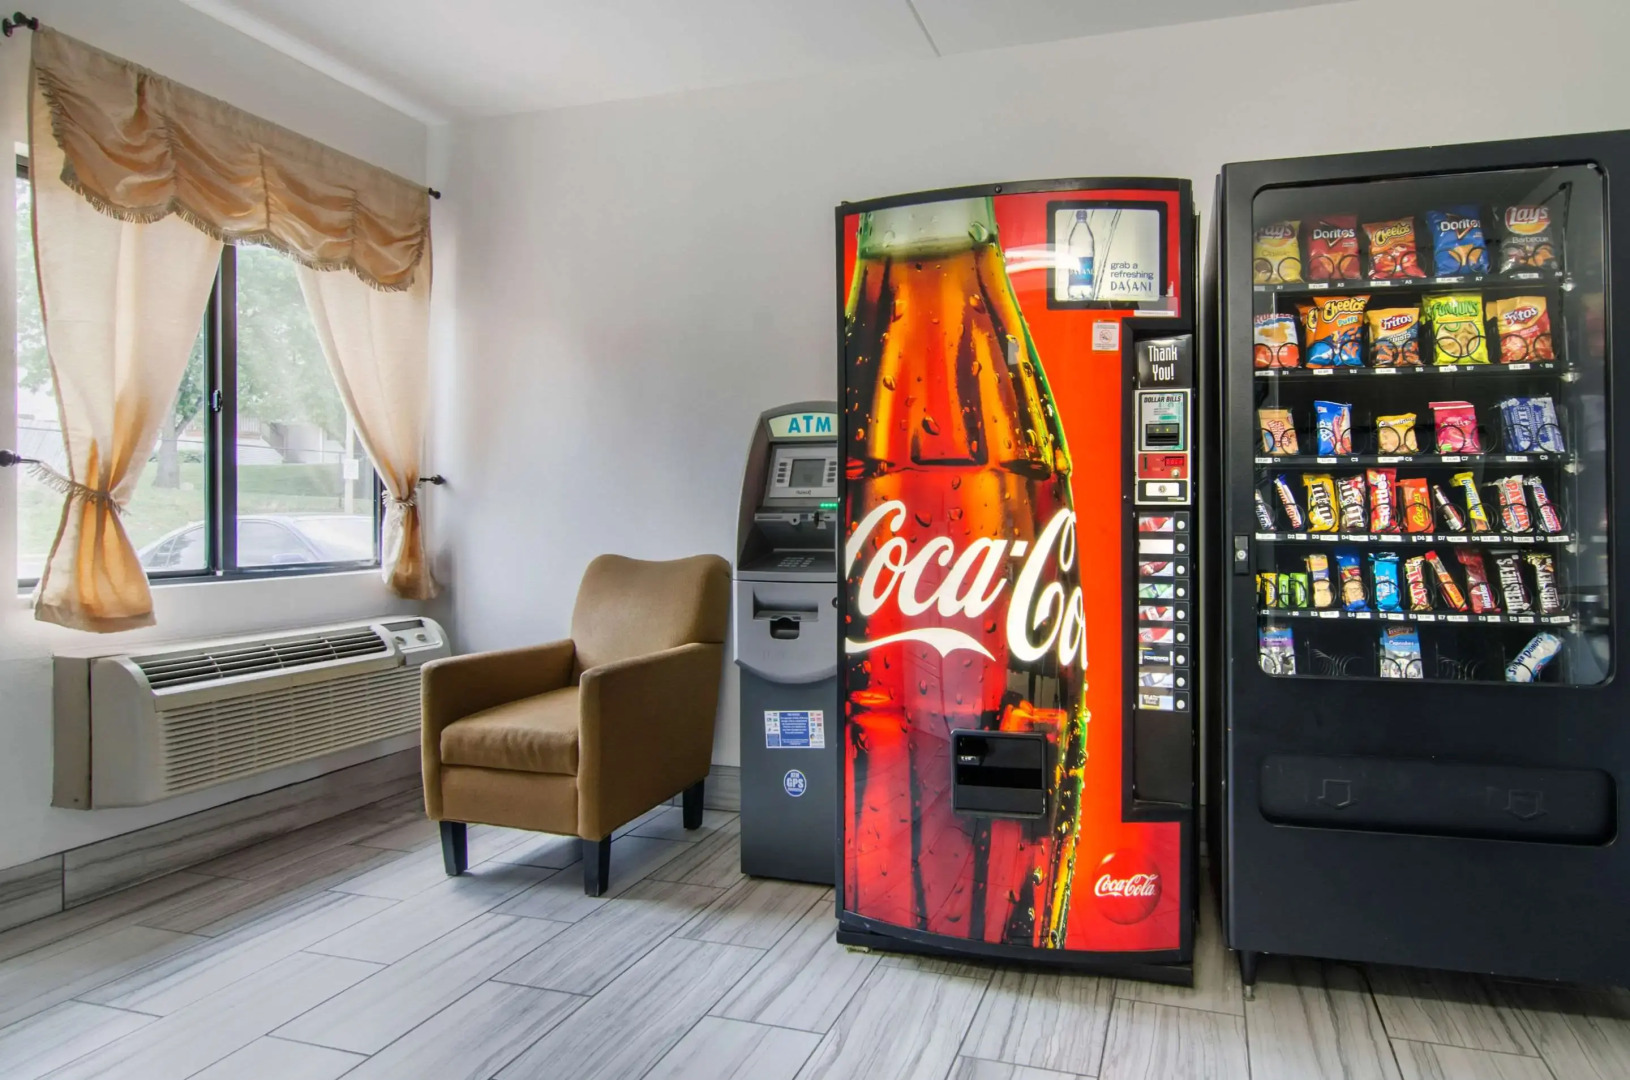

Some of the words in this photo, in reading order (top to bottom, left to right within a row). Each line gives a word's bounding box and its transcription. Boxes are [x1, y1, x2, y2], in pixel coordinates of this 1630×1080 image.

[1313, 228, 1355, 240] Doritos
[1374, 223, 1410, 246] Cheetos
[1110, 261, 1131, 271] grab
[1110, 270, 1154, 280] refreshing
[1110, 279, 1152, 294] DASANI
[1322, 297, 1366, 323] Cheetos
[1503, 307, 1539, 327] Fritos
[1380, 314, 1413, 330] Fritos
[1147, 343, 1178, 362] Thank
[1152, 363, 1175, 382] You!
[1143, 396, 1165, 404] DOLLAR
[1165, 395, 1182, 403] BILLS
[787, 415, 832, 434] ATM
[1522, 634, 1544, 660] DONUTS
[786, 777, 804, 790] GPS
[1094, 873, 1159, 897] Coca-Cola
